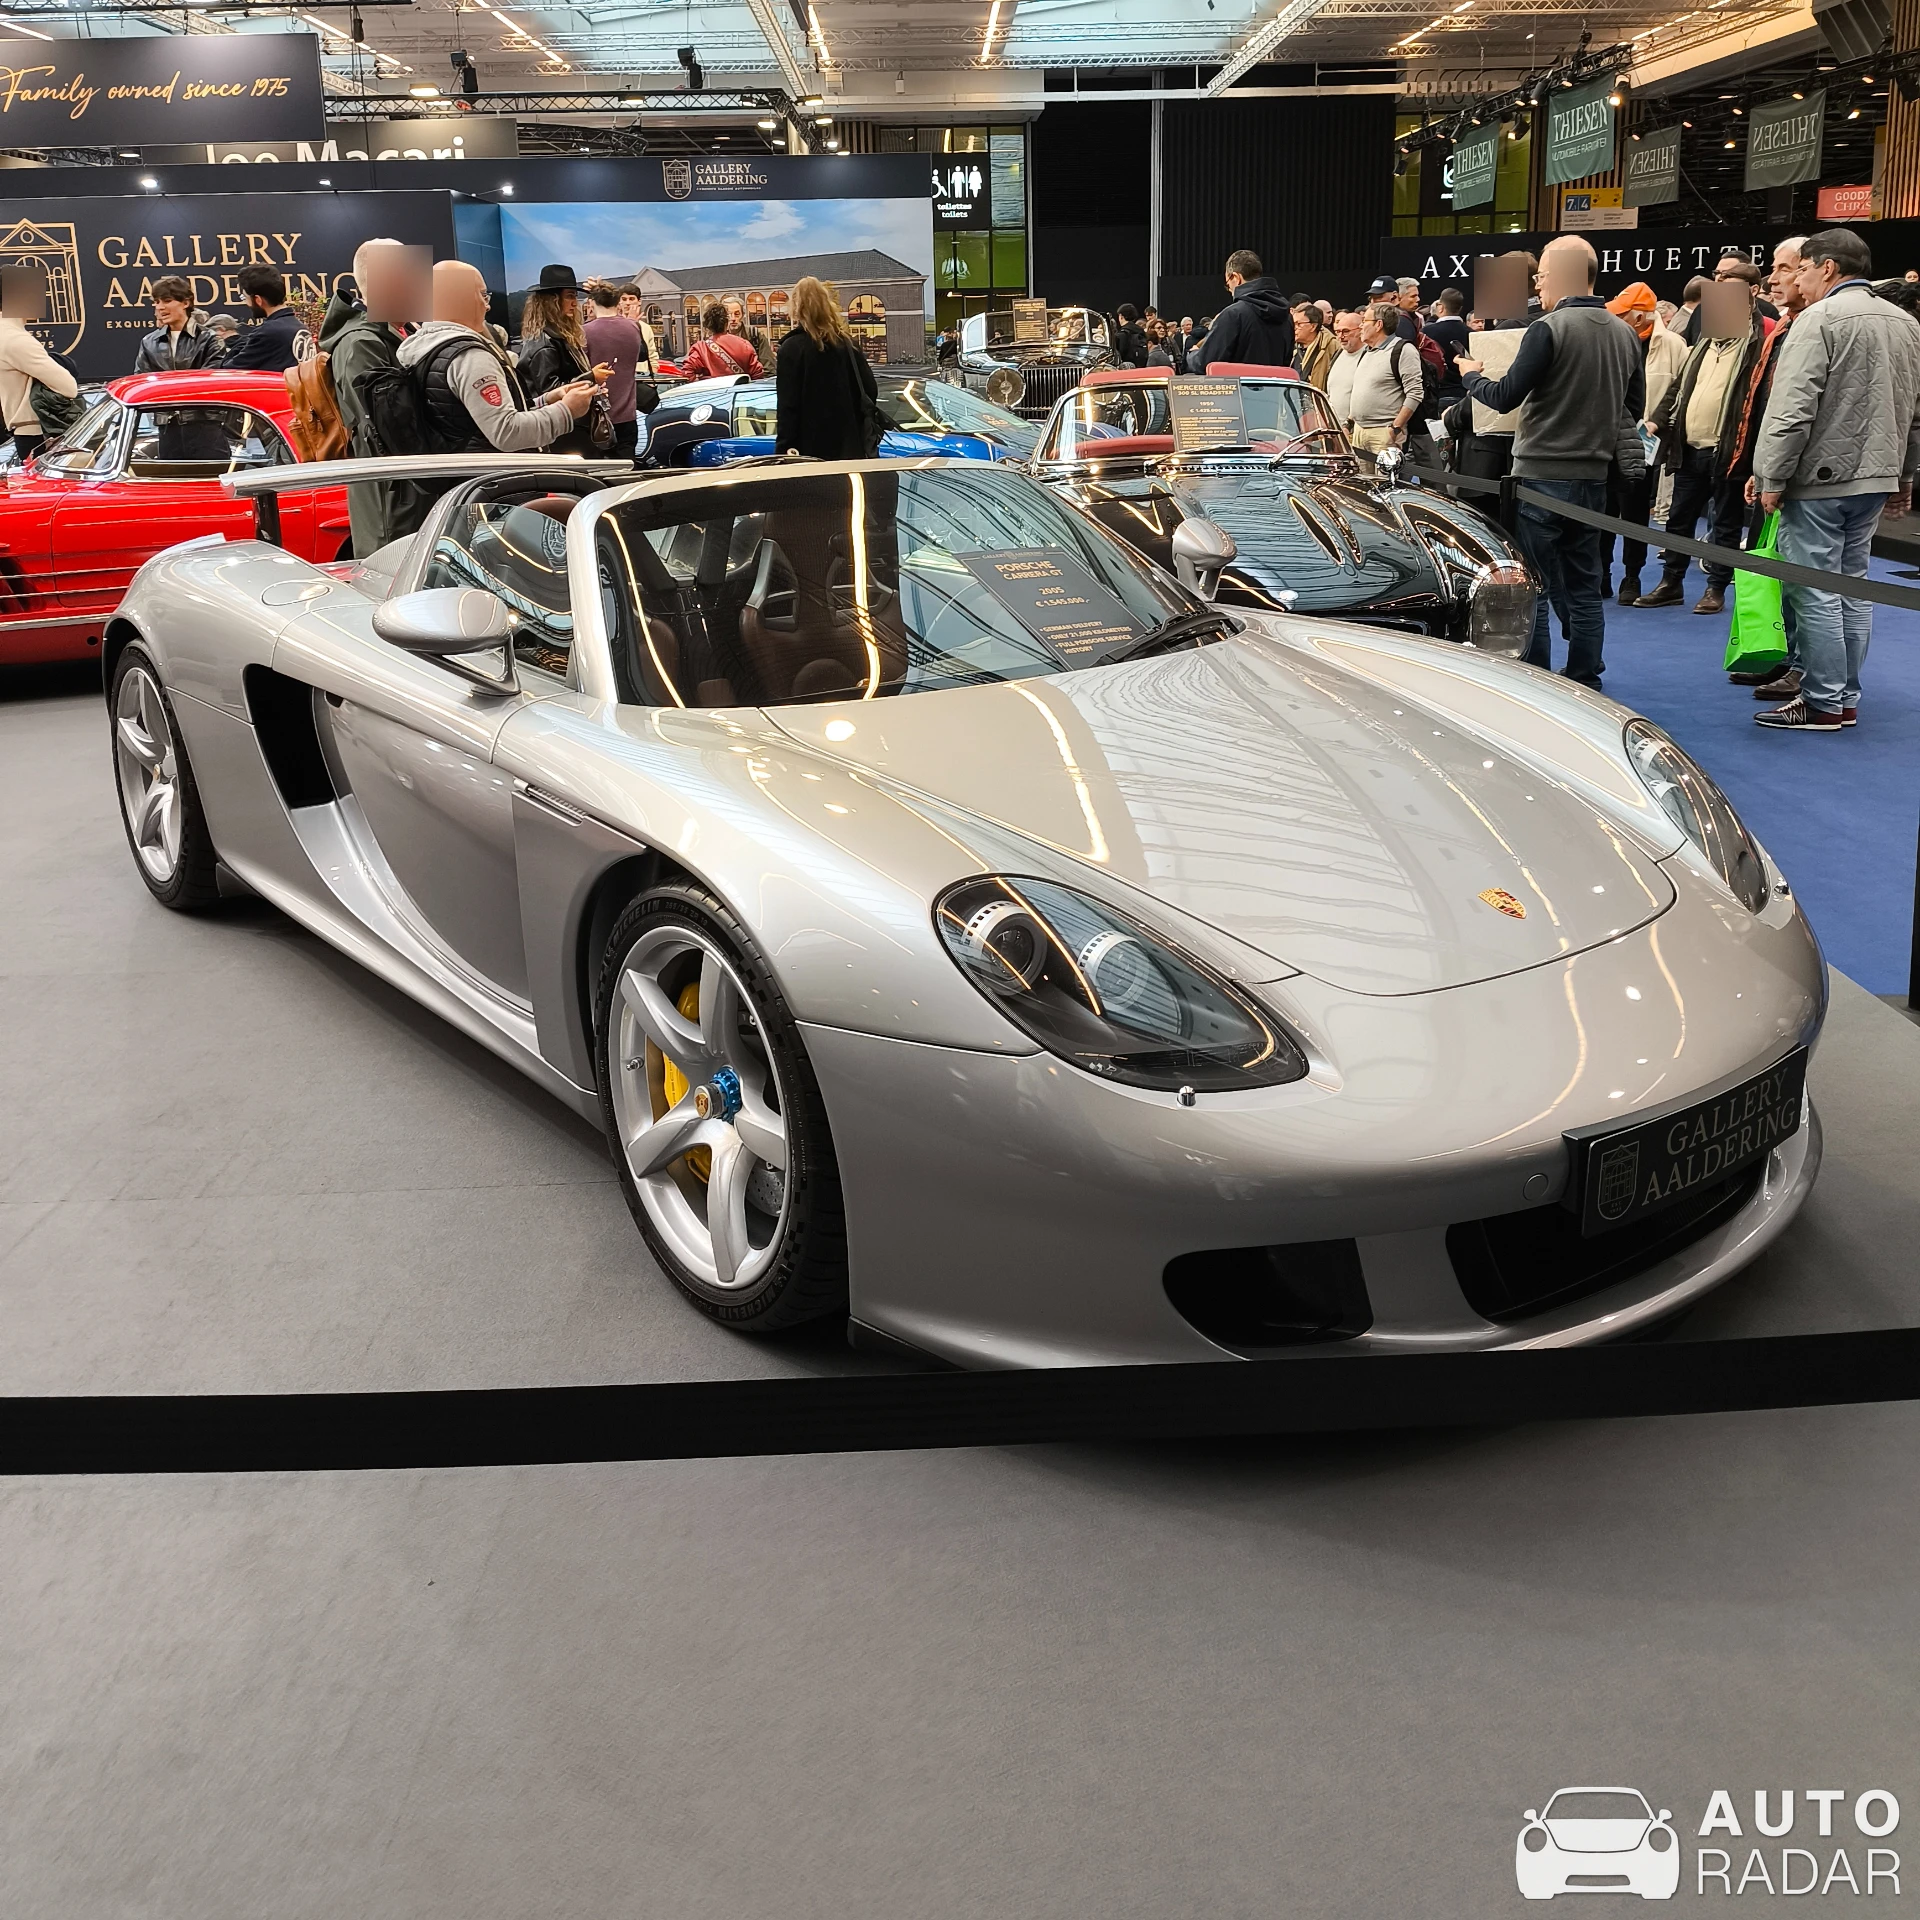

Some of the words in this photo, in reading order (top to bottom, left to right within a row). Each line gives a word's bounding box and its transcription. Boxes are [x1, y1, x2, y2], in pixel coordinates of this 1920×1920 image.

[0, 65, 101, 119] Family
[108, 71, 181, 103] owned
[182, 78, 248, 100] since
[250, 77, 292, 97] 1975
[1553, 96, 1611, 142] THIESEN
[1456, 139, 1495, 174] THIESEN
[695, 163, 752, 174] GALLERY
[695, 174, 768, 185] AALDERING
[1580, 198, 1588, 209] 4
[97, 232, 302, 268] GALLERY
[103, 272, 361, 308] AADEING
[106, 320, 155, 329] EXQUIS
[994, 560, 1056, 573] PORSCHE
[1003, 570, 1051, 580] CARRERA
[1049, 569, 1064, 577] GT
[1038, 586, 1065, 595] 2005
[1043, 623, 1073, 632] GERMAN
[1072, 620, 1103, 629] DELIVERY
[1051, 632, 1069, 640] ONLY
[1092, 626, 1132, 635] KILOMETERS
[1058, 640, 1077, 648] FULL
[1076, 637, 1107, 646] PORSCHE
[1105, 634, 1133, 642] SERVICE
[1063, 645, 1094, 655] HISTORY
[613, 899, 660, 947] MICHELIN
[1667, 1067, 1788, 1156] GALLERY
[1641, 1098, 1796, 1207] AALDERING
